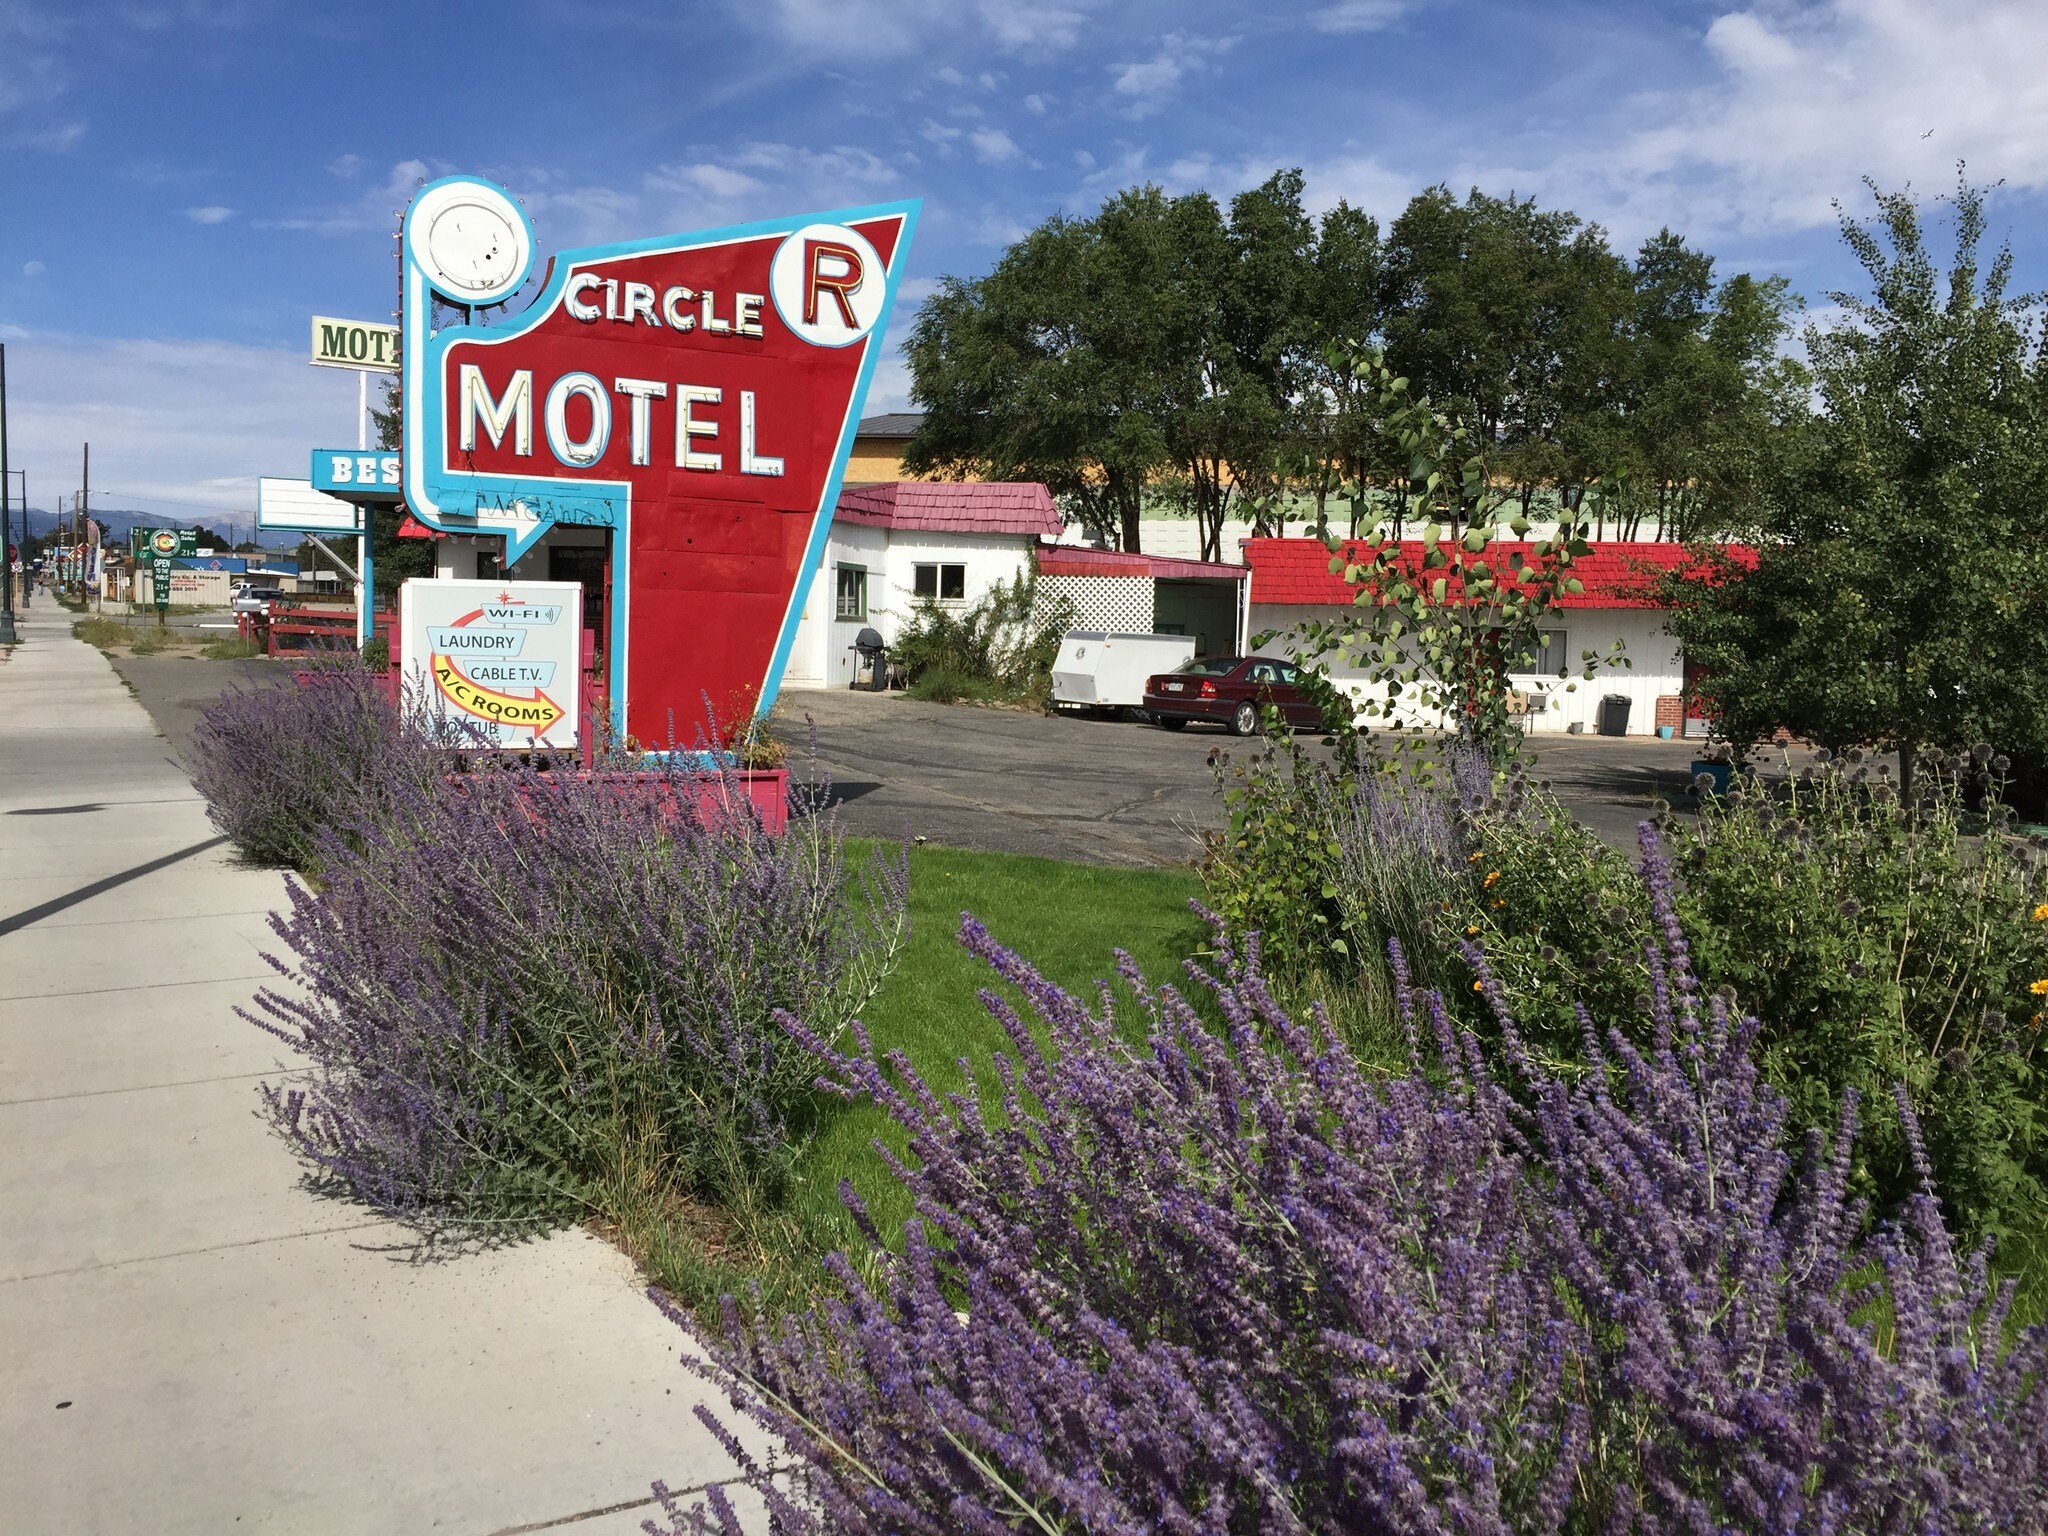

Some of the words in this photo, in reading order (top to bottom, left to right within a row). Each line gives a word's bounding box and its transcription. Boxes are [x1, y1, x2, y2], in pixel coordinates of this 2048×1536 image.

[563, 271, 766, 338] CIRCLE
[801, 238, 862, 329] R
[458, 363, 785, 476] MOTEL
[181, 549, 196, 557] 21+
[153, 559, 171, 567] OPEN
[488, 609, 539, 618] WI-FI
[439, 635, 515, 649] LAUNDRY
[470, 667, 516, 680] CABLE
[519, 668, 542, 680] T.V.
[436, 668, 471, 700] A/C
[471, 695, 554, 720] ROOMS
